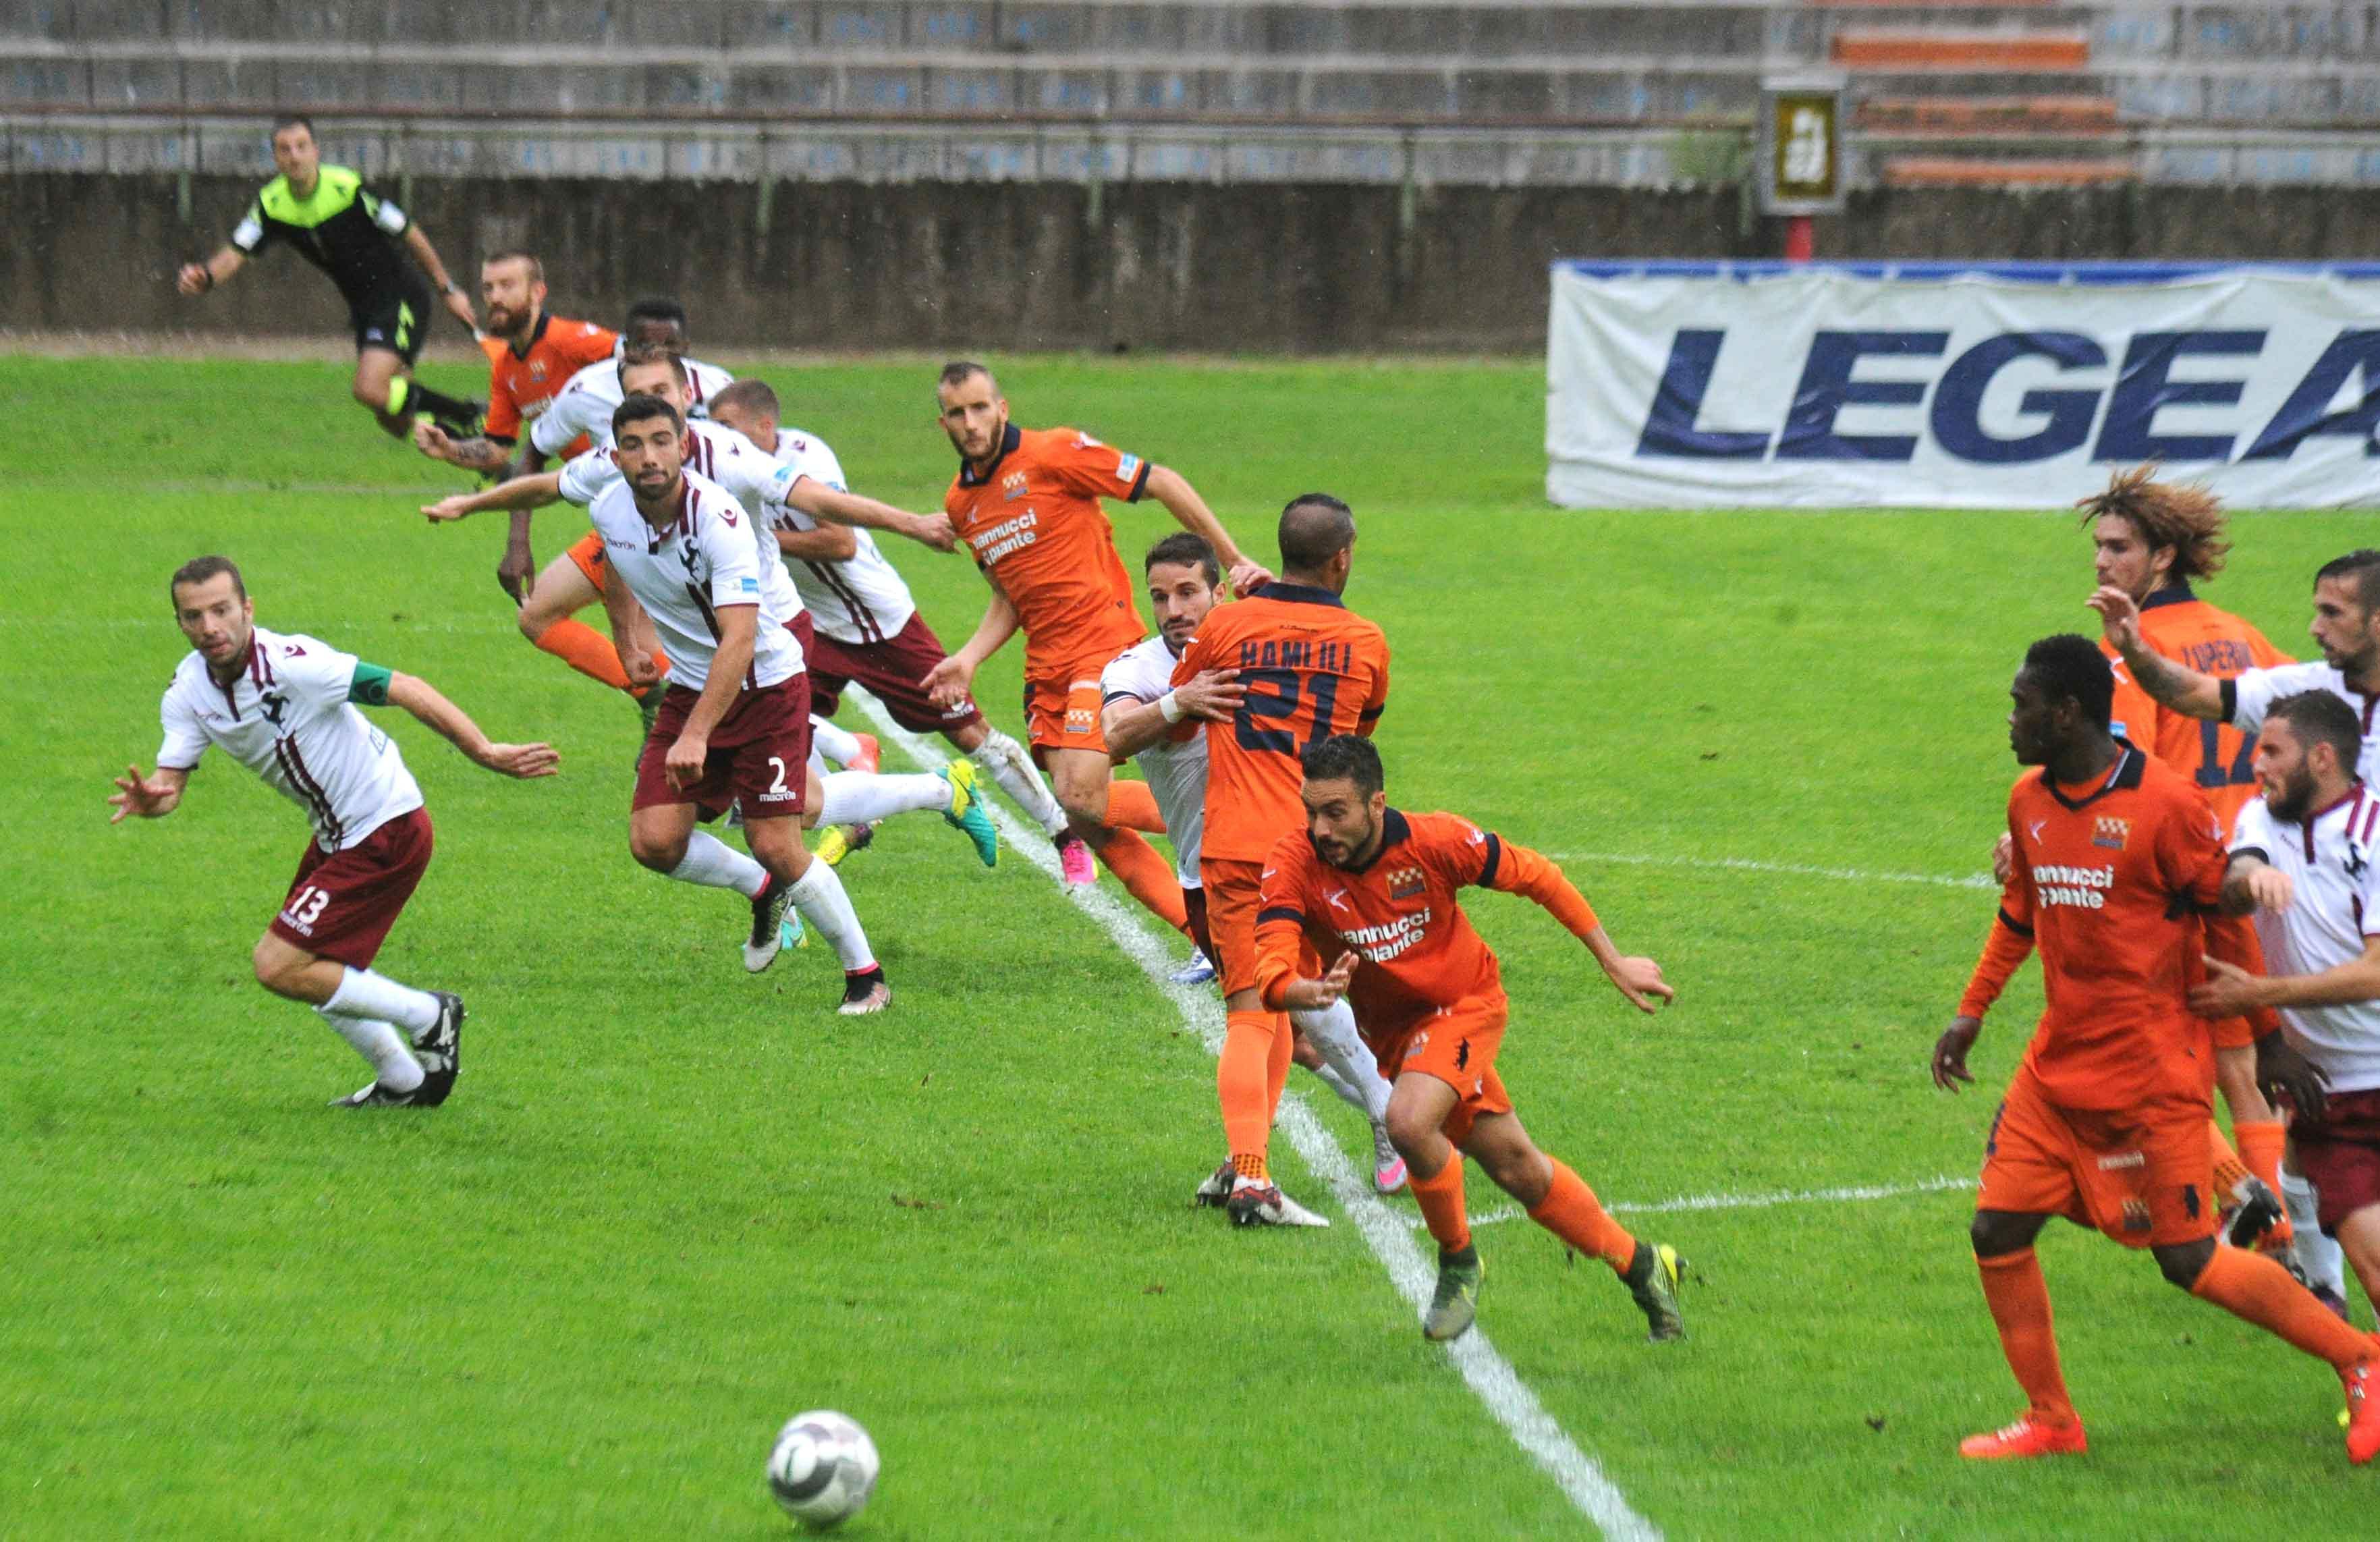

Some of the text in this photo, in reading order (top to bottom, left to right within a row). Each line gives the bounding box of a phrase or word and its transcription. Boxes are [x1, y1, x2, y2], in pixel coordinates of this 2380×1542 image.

[1636, 328, 2380, 464] LEGEA
[1240, 640, 1352, 675] HAMLILI
[1234, 667, 1339, 759] 21
[768, 756, 788, 794] 2
[288, 885, 330, 924] 13
